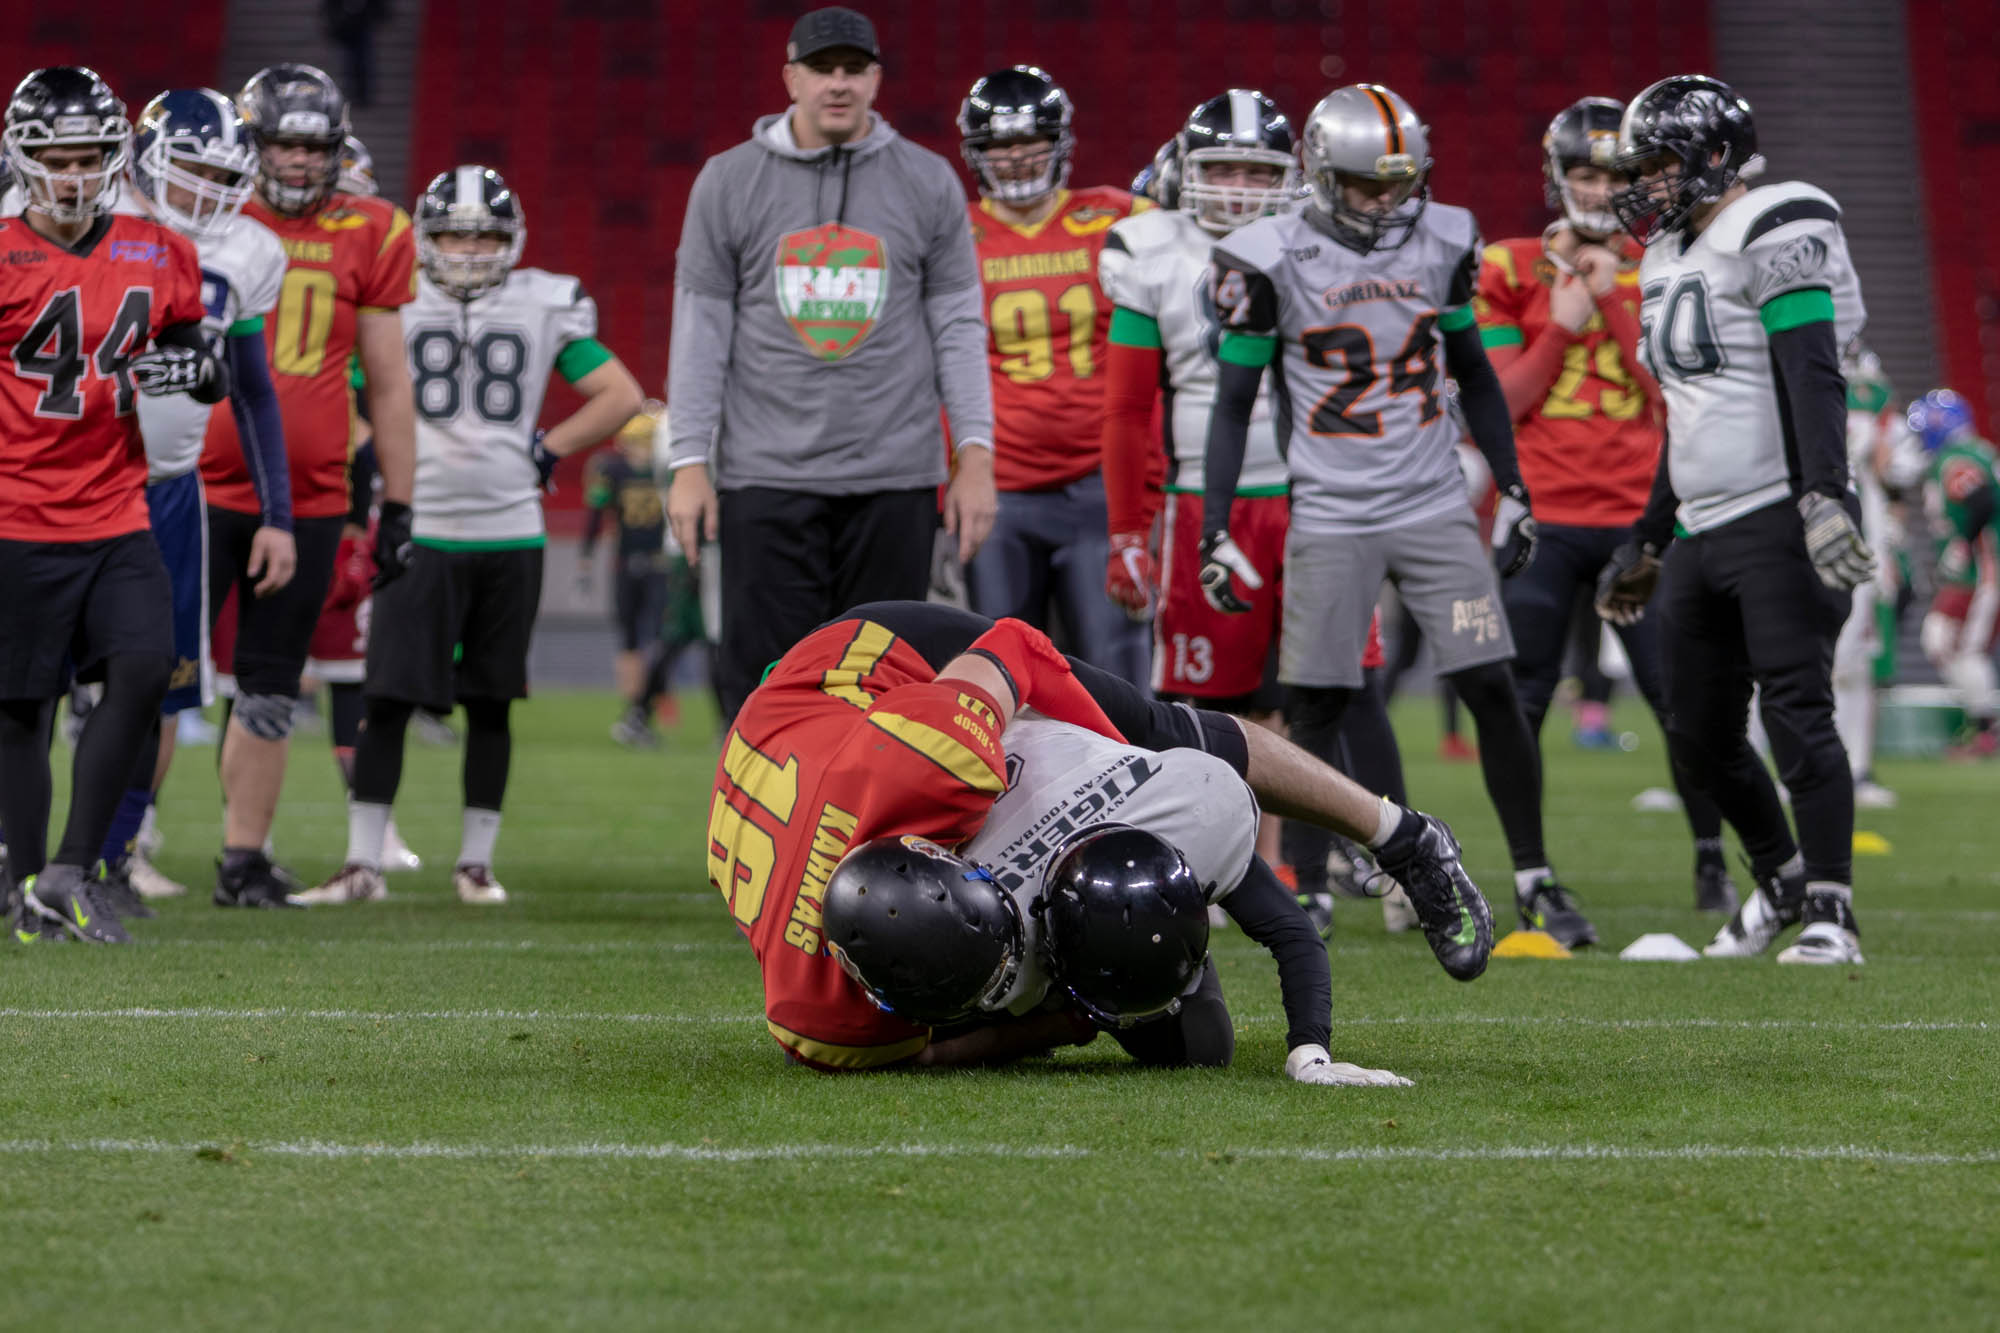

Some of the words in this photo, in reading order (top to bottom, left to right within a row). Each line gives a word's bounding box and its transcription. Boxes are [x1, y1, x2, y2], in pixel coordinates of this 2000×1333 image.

[10, 286, 154, 420] 44
[409, 325, 527, 423] 88
[991, 283, 1095, 384] 91
[1301, 308, 1443, 437] 24
[1173, 632, 1214, 683] 13
[953, 713, 990, 748] RECOP
[707, 729, 798, 928] 16
[998, 799, 1069, 858] FOOTBALL
